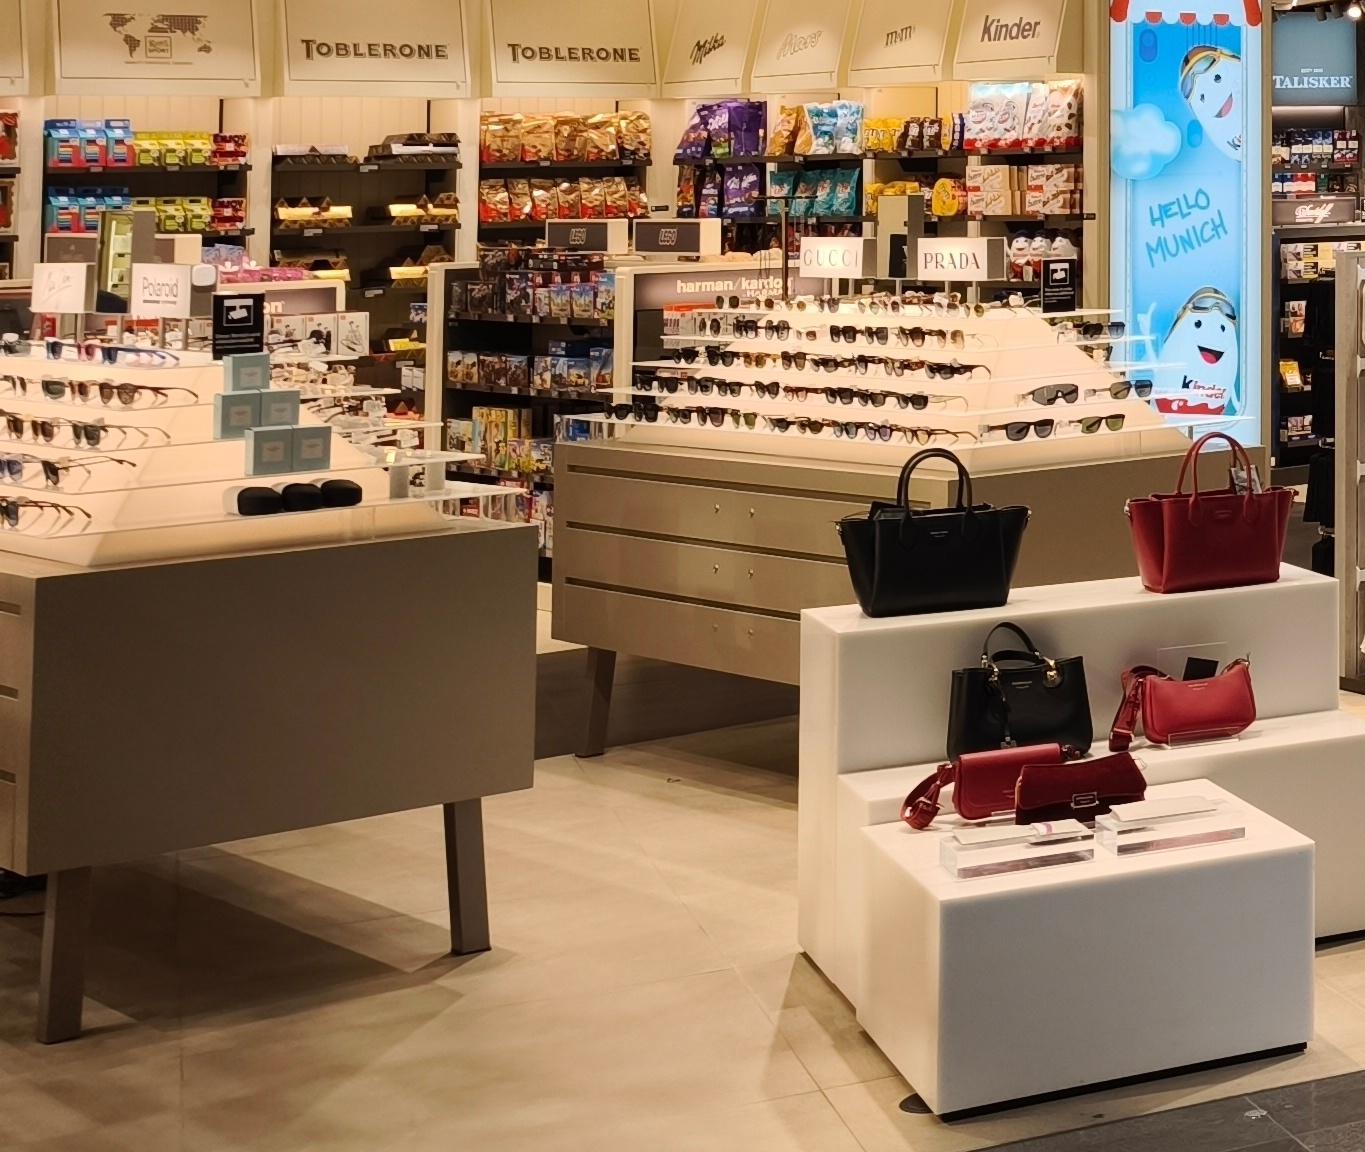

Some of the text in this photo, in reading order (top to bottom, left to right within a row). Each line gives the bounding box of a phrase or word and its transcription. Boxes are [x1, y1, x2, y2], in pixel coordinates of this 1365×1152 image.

[980, 14, 1041, 42] Kinder
[1273, 75, 1352, 89] TALISKER
[1149, 188, 1211, 227] HELLO
[569, 228, 587, 245] LEGO
[658, 228, 678, 245] LEGO
[1145, 209, 1229, 268] MUNICH
[803, 247, 859, 268] GUCCI
[923, 251, 980, 271] PRADA
[142, 275, 180, 298] Polaroid
